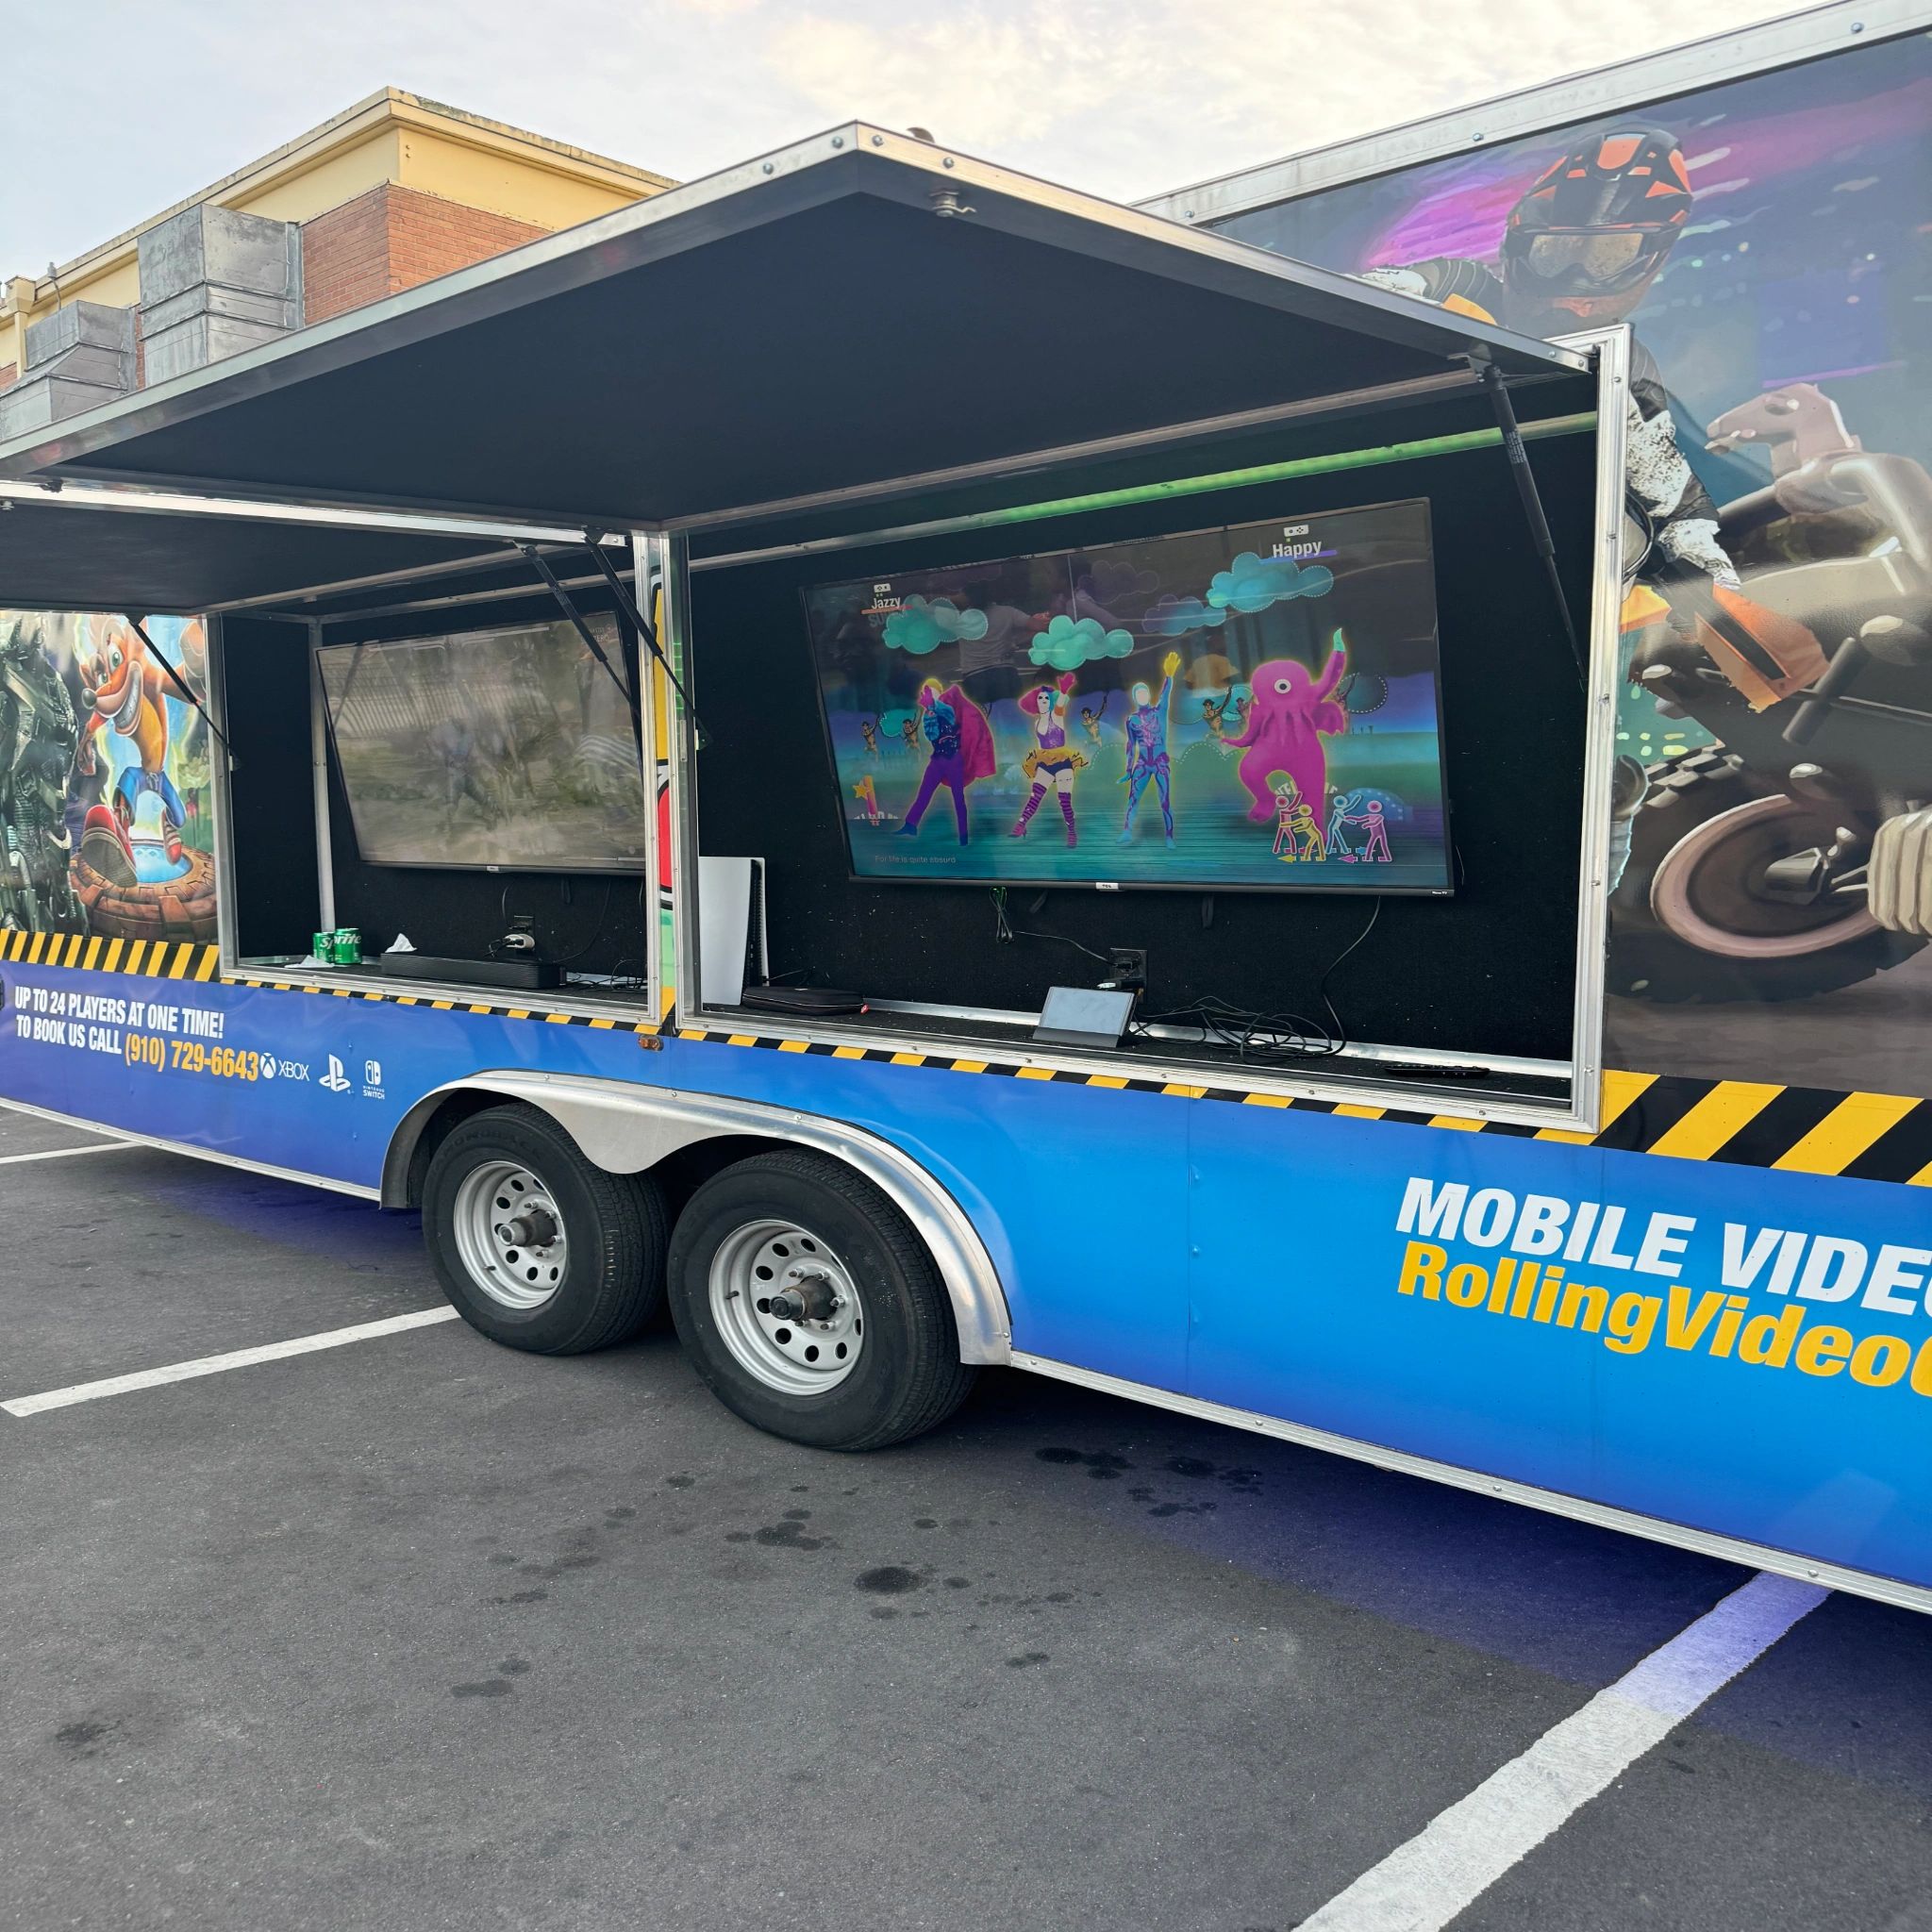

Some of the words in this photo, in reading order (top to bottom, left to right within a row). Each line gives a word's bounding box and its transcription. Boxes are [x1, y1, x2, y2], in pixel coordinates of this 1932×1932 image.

[1273, 541, 1322, 558] Happy
[871, 596, 900, 609] Jazzy
[14, 986, 31, 1009] UP
[33, 989, 48, 1013] TO
[50, 991, 66, 1015] 24
[68, 993, 126, 1024] PLAYERS
[127, 1001, 144, 1027] AT
[147, 1004, 178, 1032] ONE
[182, 1008, 225, 1039] TIME!
[16, 1014, 30, 1038] TO
[34, 1017, 66, 1044] BOOK
[69, 1024, 86, 1048] US
[89, 1026, 123, 1055] CALL
[125, 1032, 166, 1072] (910)
[171, 1040, 259, 1082] 729-6643
[278, 1059, 310, 1081] XBOX
[362, 1089, 385, 1100] SWITCH
[1395, 1176, 1697, 1278] MOBILE
[1721, 1223, 1932, 1318] VIDE
